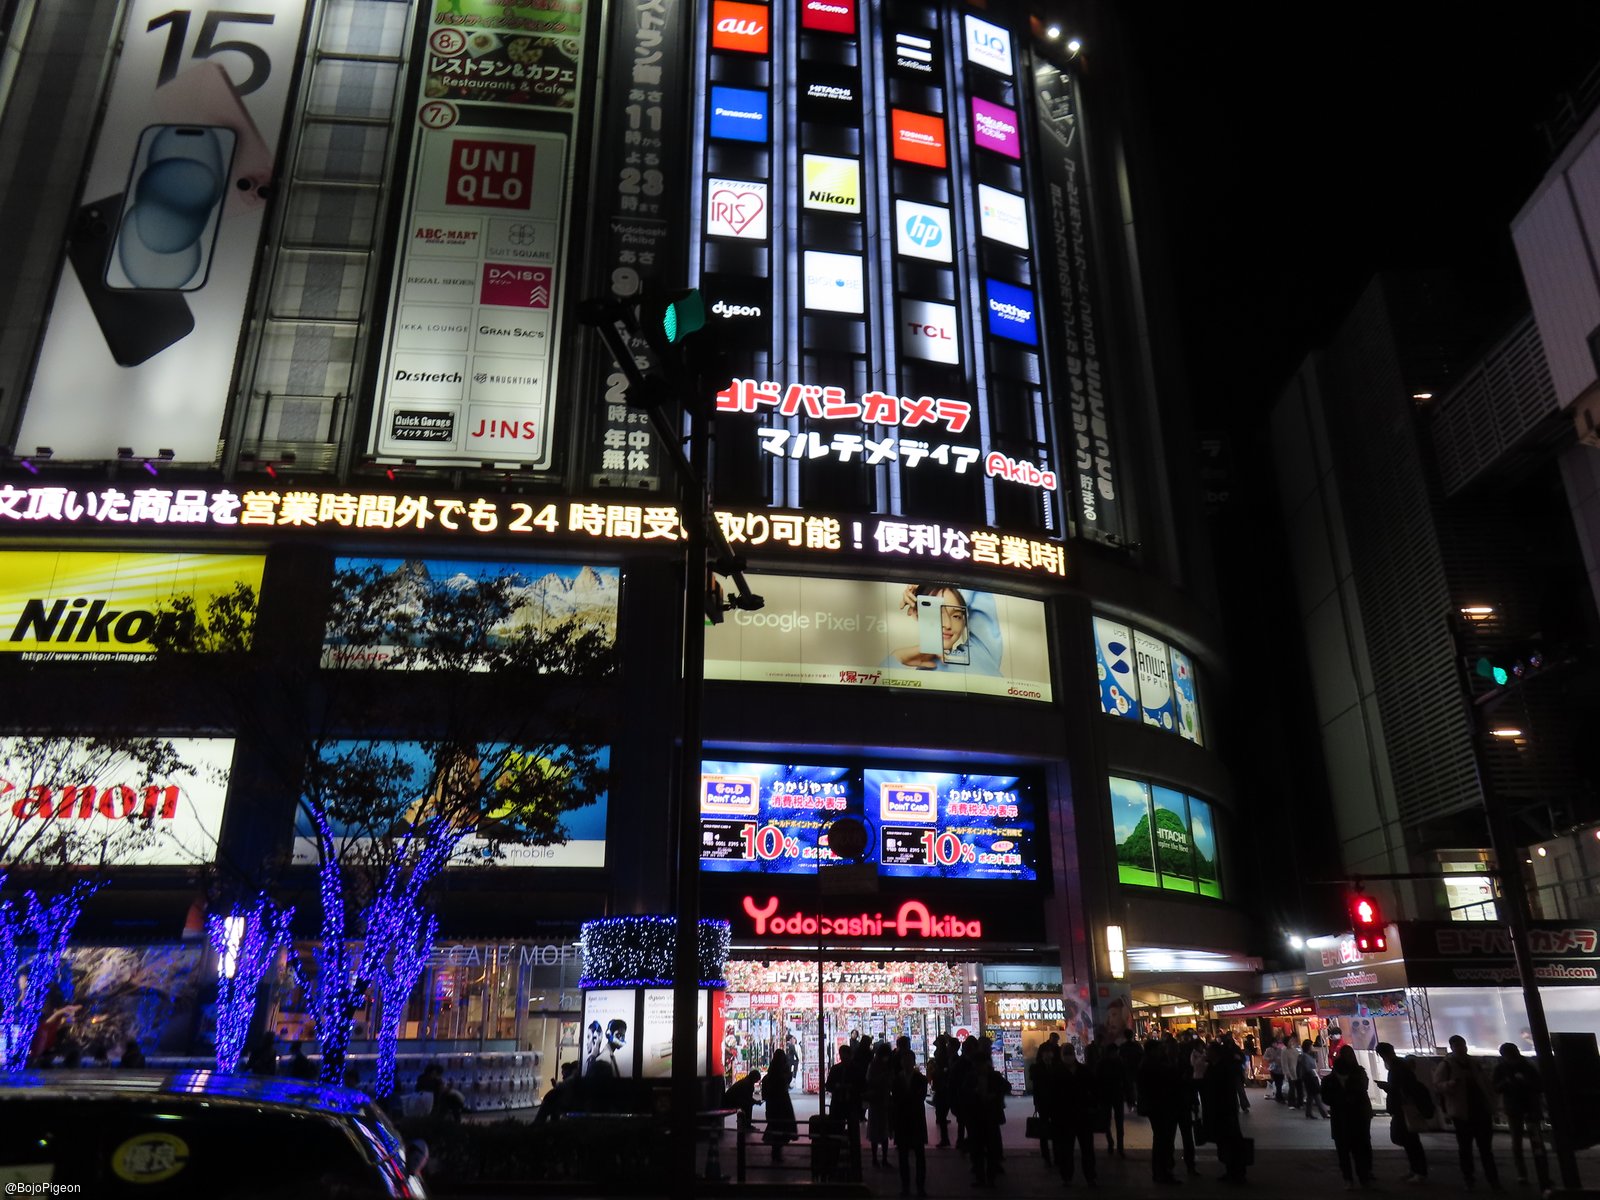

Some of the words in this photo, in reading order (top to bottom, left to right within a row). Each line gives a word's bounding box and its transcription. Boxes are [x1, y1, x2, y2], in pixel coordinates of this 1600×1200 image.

[807, 1, 849, 15] docomo
[716, 18, 764, 36] au
[973, 30, 1005, 54] UQ
[146, 10, 275, 97] 15
[442, 75, 516, 91] Restaurants
[519, 80, 530, 91] &
[628, 88, 664, 103] あさ
[428, 107, 449, 124] 7F
[625, 104, 662, 131] 11
[714, 107, 763, 121] Panasonic
[976, 113, 1016, 135] Rakuten
[459, 148, 520, 174] UNI
[456, 174, 523, 202] QLO
[618, 167, 665, 197] 23
[808, 190, 855, 206] Nikon
[415, 228, 478, 241] ABC-MART
[610, 222, 667, 237] Yodobashi
[909, 215, 940, 248] hp
[621, 233, 656, 246] Akiba
[513, 251, 550, 260] SQUARE
[408, 276, 440, 285] REGAL
[442, 278, 475, 287] SHOES
[711, 300, 762, 318] dyson
[988, 298, 1031, 321] brother
[427, 325, 469, 333] LOUNGE
[907, 322, 952, 341] TCL
[395, 370, 462, 384] Dr.stretch
[395, 415, 420, 426] Quick
[420, 416, 452, 428] Garage
[604, 429, 650, 450] 年中
[602, 450, 650, 471] 無休
[757, 427, 980, 474] マルチメディア
[985, 452, 1057, 491] Akiba
[508, 502, 560, 533] 24
[9, 599, 194, 645] Niko
[734, 611, 809, 633] Google
[815, 613, 860, 632] Pixel
[865, 616, 888, 633] 7a
[21, 652, 158, 664] http://www.nikon-image.c
[1137, 651, 1168, 681] ANWA
[1140, 673, 1169, 689] UPPLY
[1007, 686, 1041, 699] docomo
[773, 780, 845, 795] わかりやすい
[950, 789, 1017, 803] わかりやすい
[1156, 828, 1187, 844] HITACHI
[511, 847, 555, 859] mobile
[1436, 928, 1598, 955] ヨドバカメラ
[448, 944, 509, 966] CAFE
[1453, 964, 1598, 985] www.yodashi.com
[999, 999, 1065, 1012] KAMUKUR
